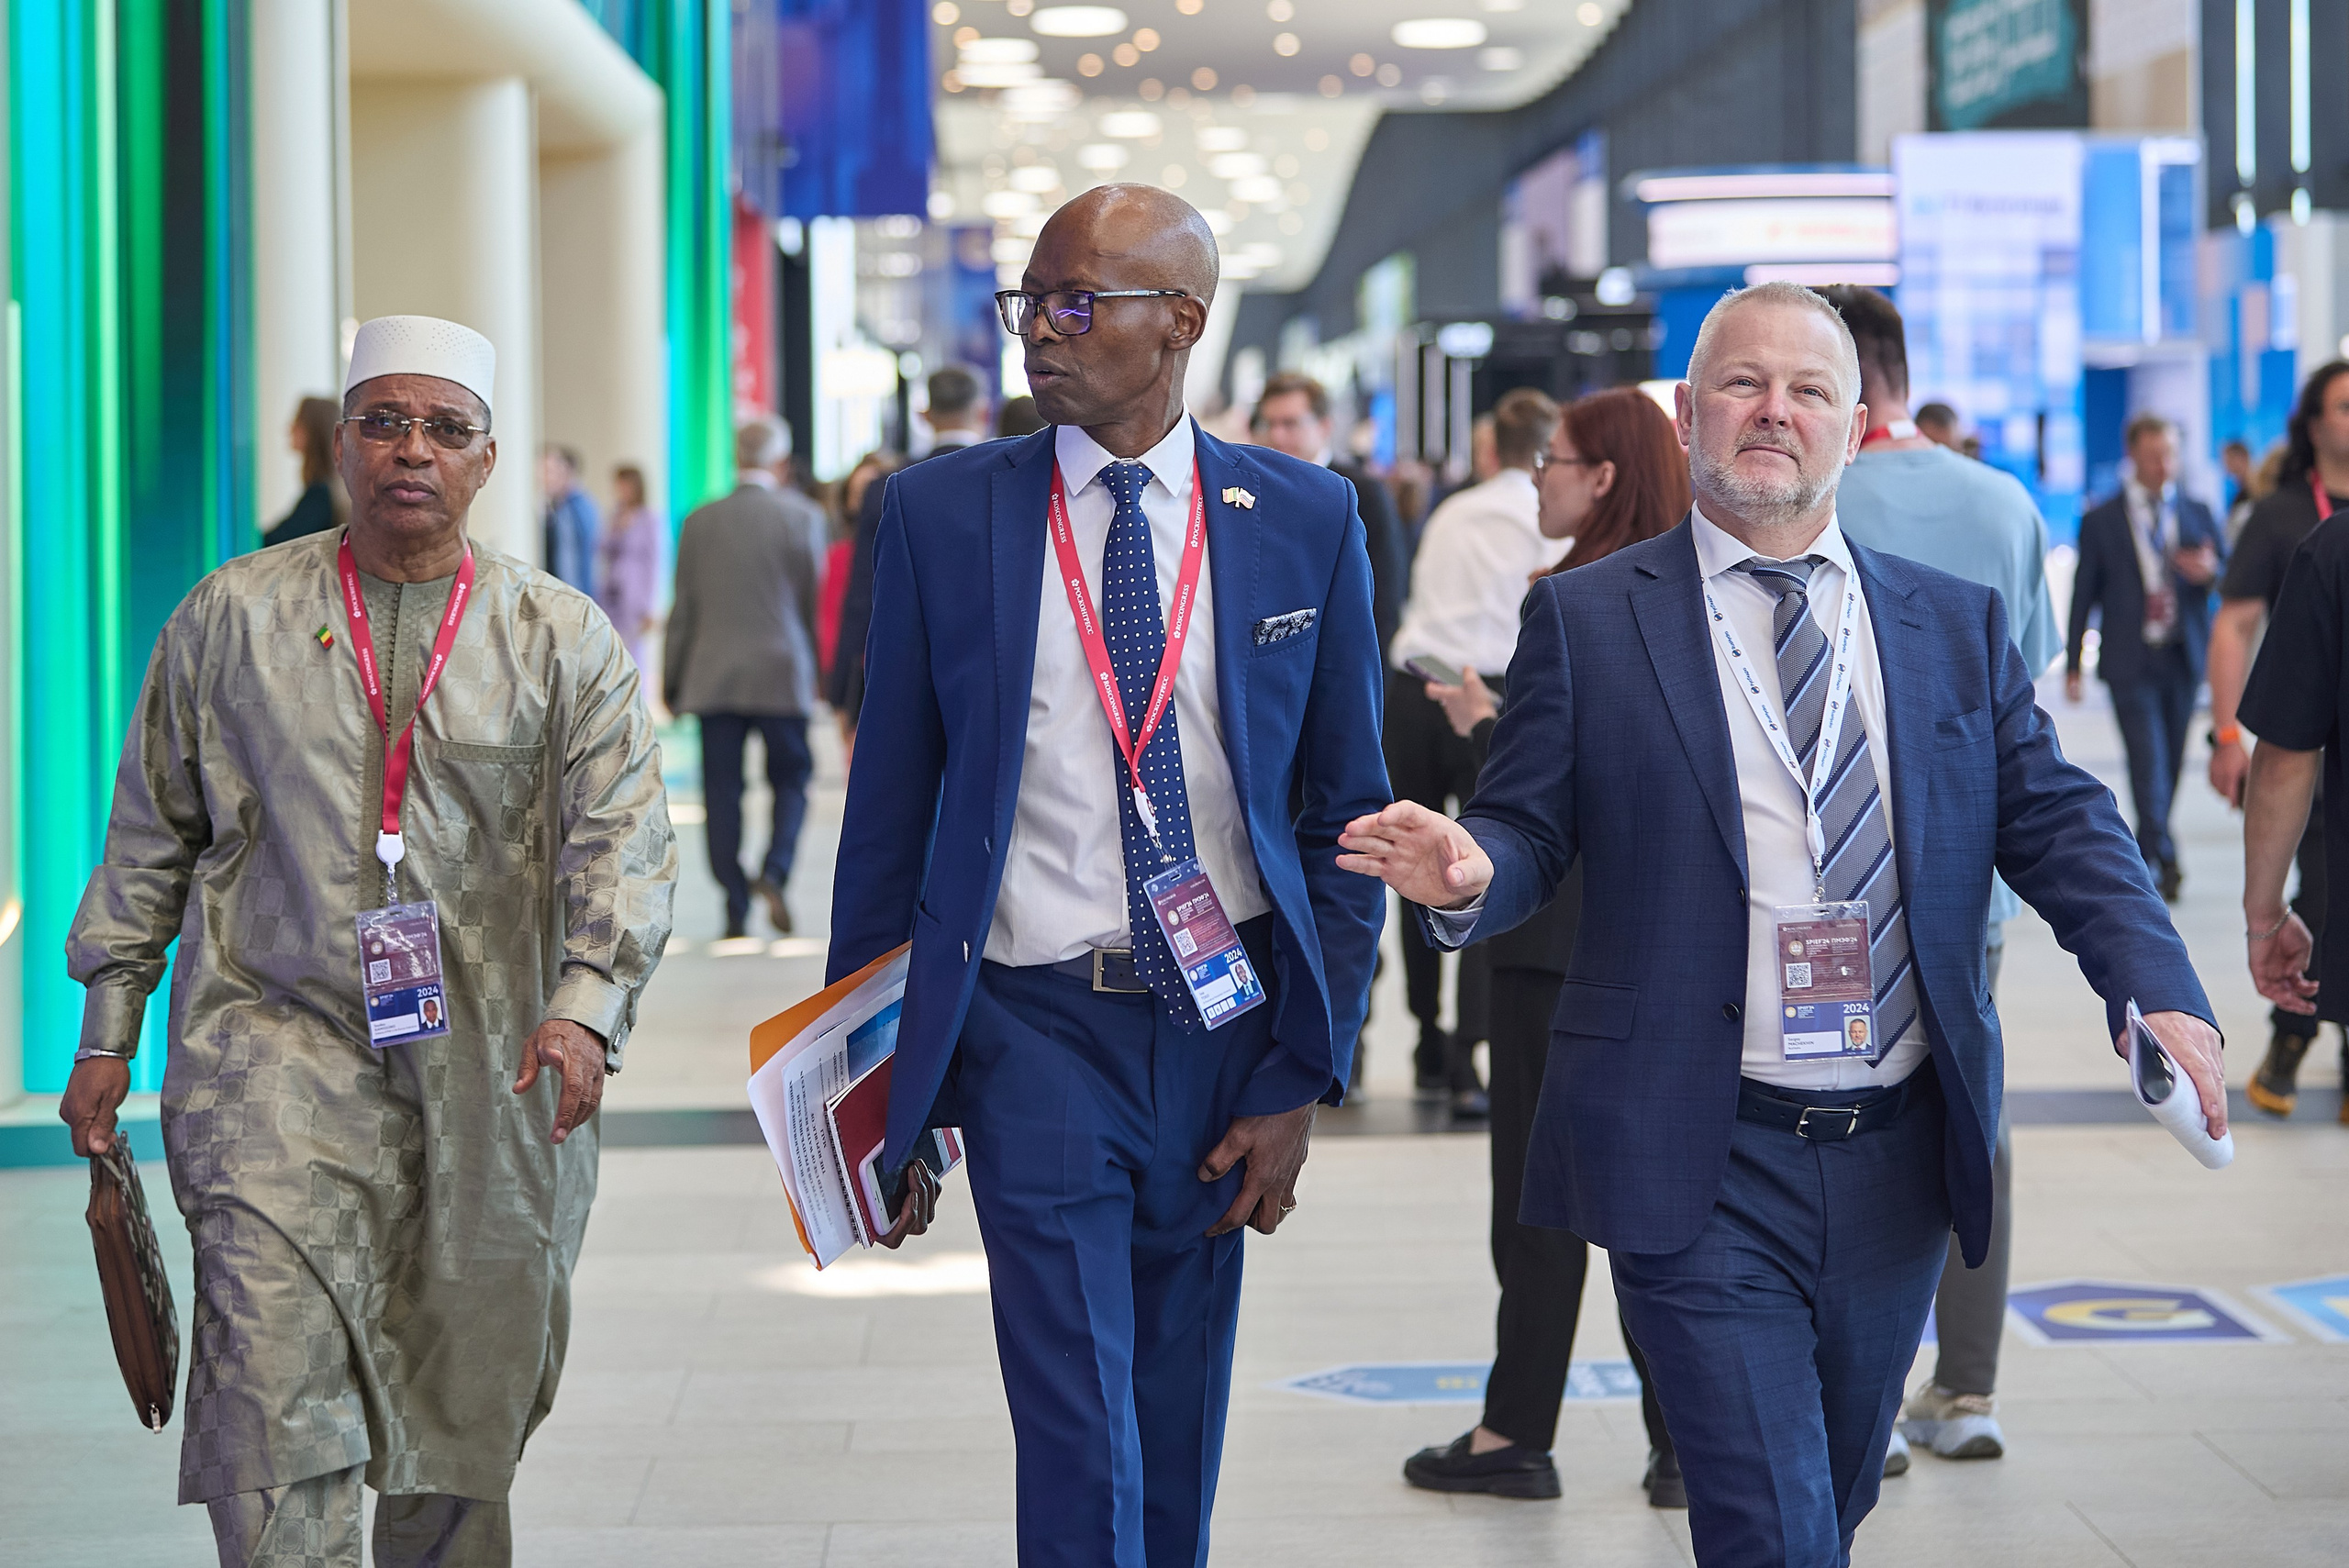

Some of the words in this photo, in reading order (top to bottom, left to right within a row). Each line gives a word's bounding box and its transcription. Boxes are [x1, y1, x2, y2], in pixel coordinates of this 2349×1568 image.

[1053, 500, 1067, 543] ROSCONGRESS
[1193, 495, 1203, 540] РОСКОНГРЕСС
[1074, 586, 1094, 635] РОСКОНГРЕСС
[1176, 584, 1190, 631] ROSCONGRESS
[1103, 680, 1123, 728] ROSCONGRESS
[1149, 675, 1169, 725] РОСКОНГРЕСС
[1224, 948, 1242, 963] 2024
[417, 985, 439, 997] 2024
[1842, 1003, 1870, 1014] 2024
[805, 1126, 813, 1152] WATER
[811, 1124, 822, 1158] REPUBLIC
[818, 1129, 827, 1148] MALI
